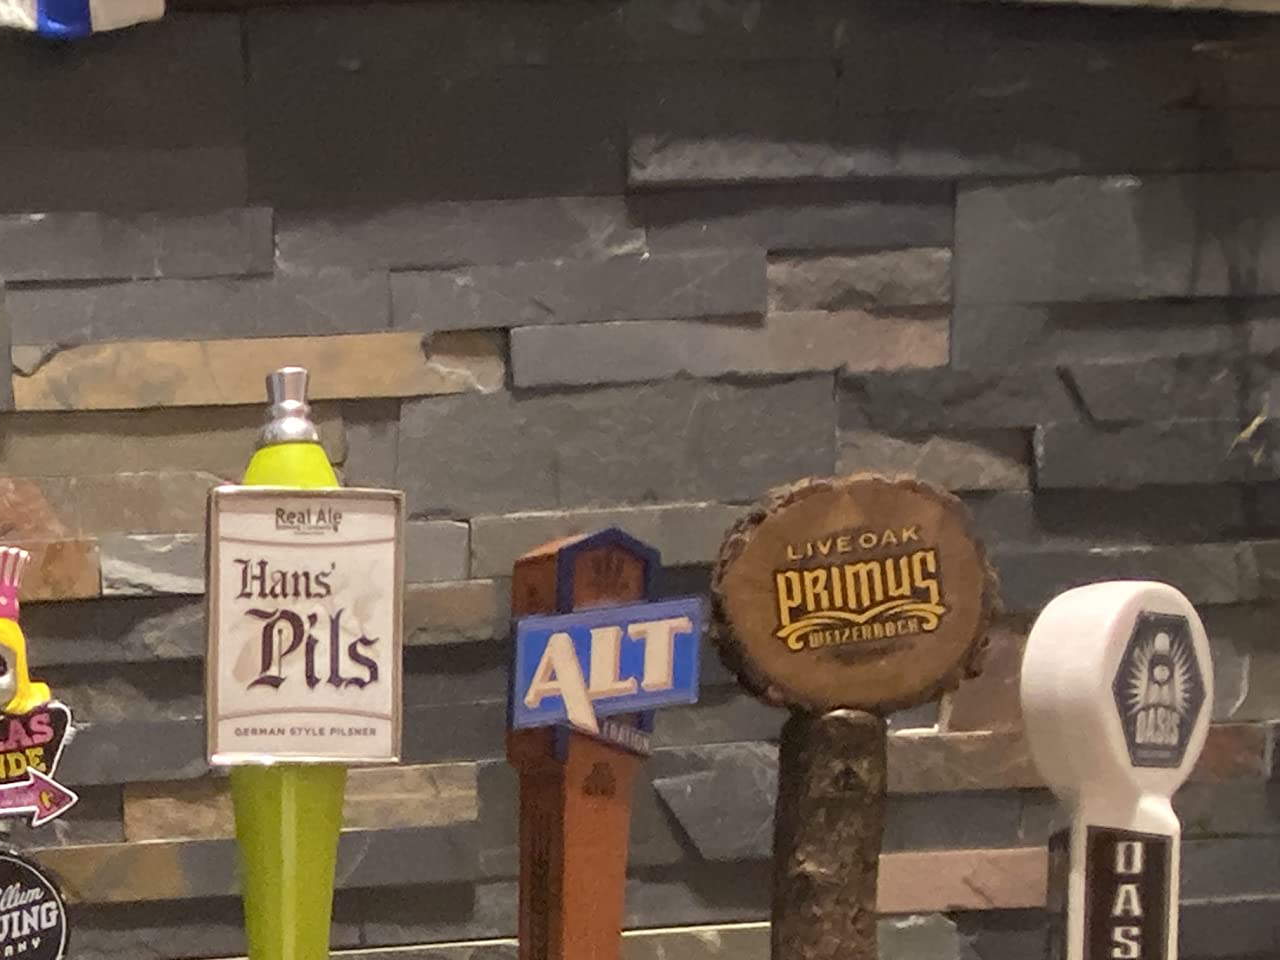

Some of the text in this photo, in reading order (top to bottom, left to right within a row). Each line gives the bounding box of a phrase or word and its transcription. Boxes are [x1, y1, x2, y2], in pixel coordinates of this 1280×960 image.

[275, 506, 343, 525] Real Ale
[787, 527, 919, 561] LIVE OAK
[234, 558, 336, 599] Hans'
[776, 551, 940, 626] PRIMUS
[244, 608, 379, 689] Pils
[524, 616, 693, 734] ALT
[235, 727, 376, 736] GERMAN STYLE PILSNER
